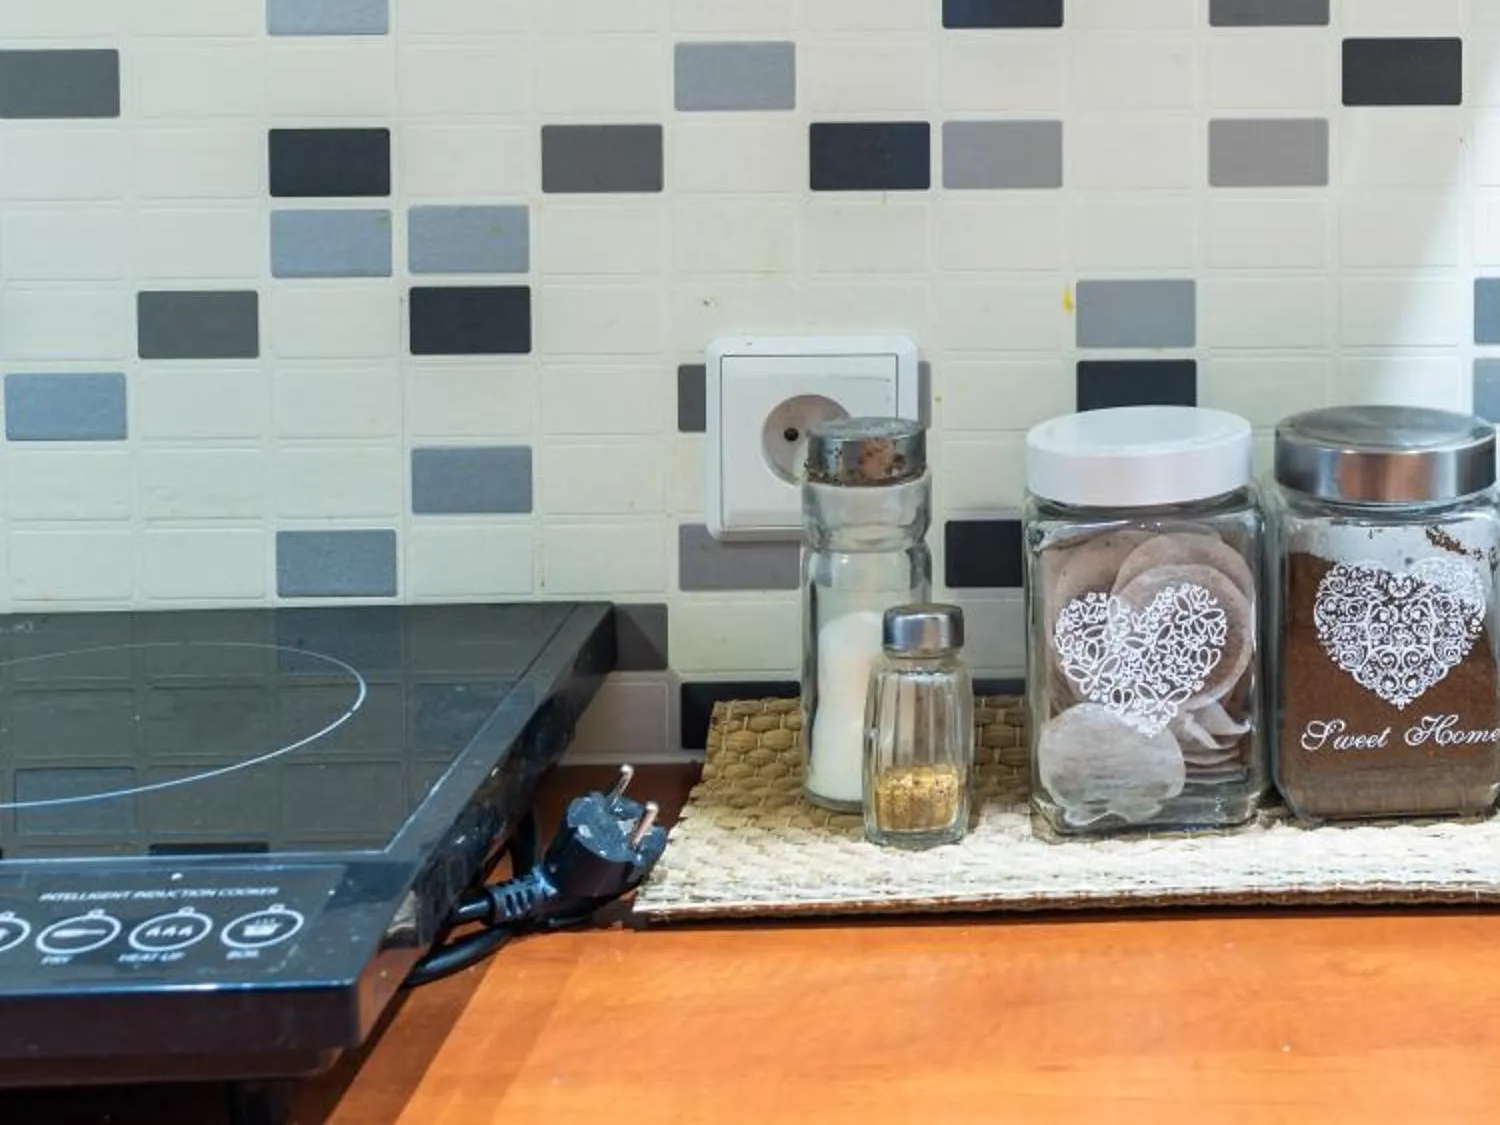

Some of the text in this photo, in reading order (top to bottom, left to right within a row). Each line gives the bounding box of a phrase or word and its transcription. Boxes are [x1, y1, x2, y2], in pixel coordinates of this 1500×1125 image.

[1300, 714, 1500, 751] Sweet Home
[39, 887, 279, 902] INTELLIGENT INDUCTION COOKER
